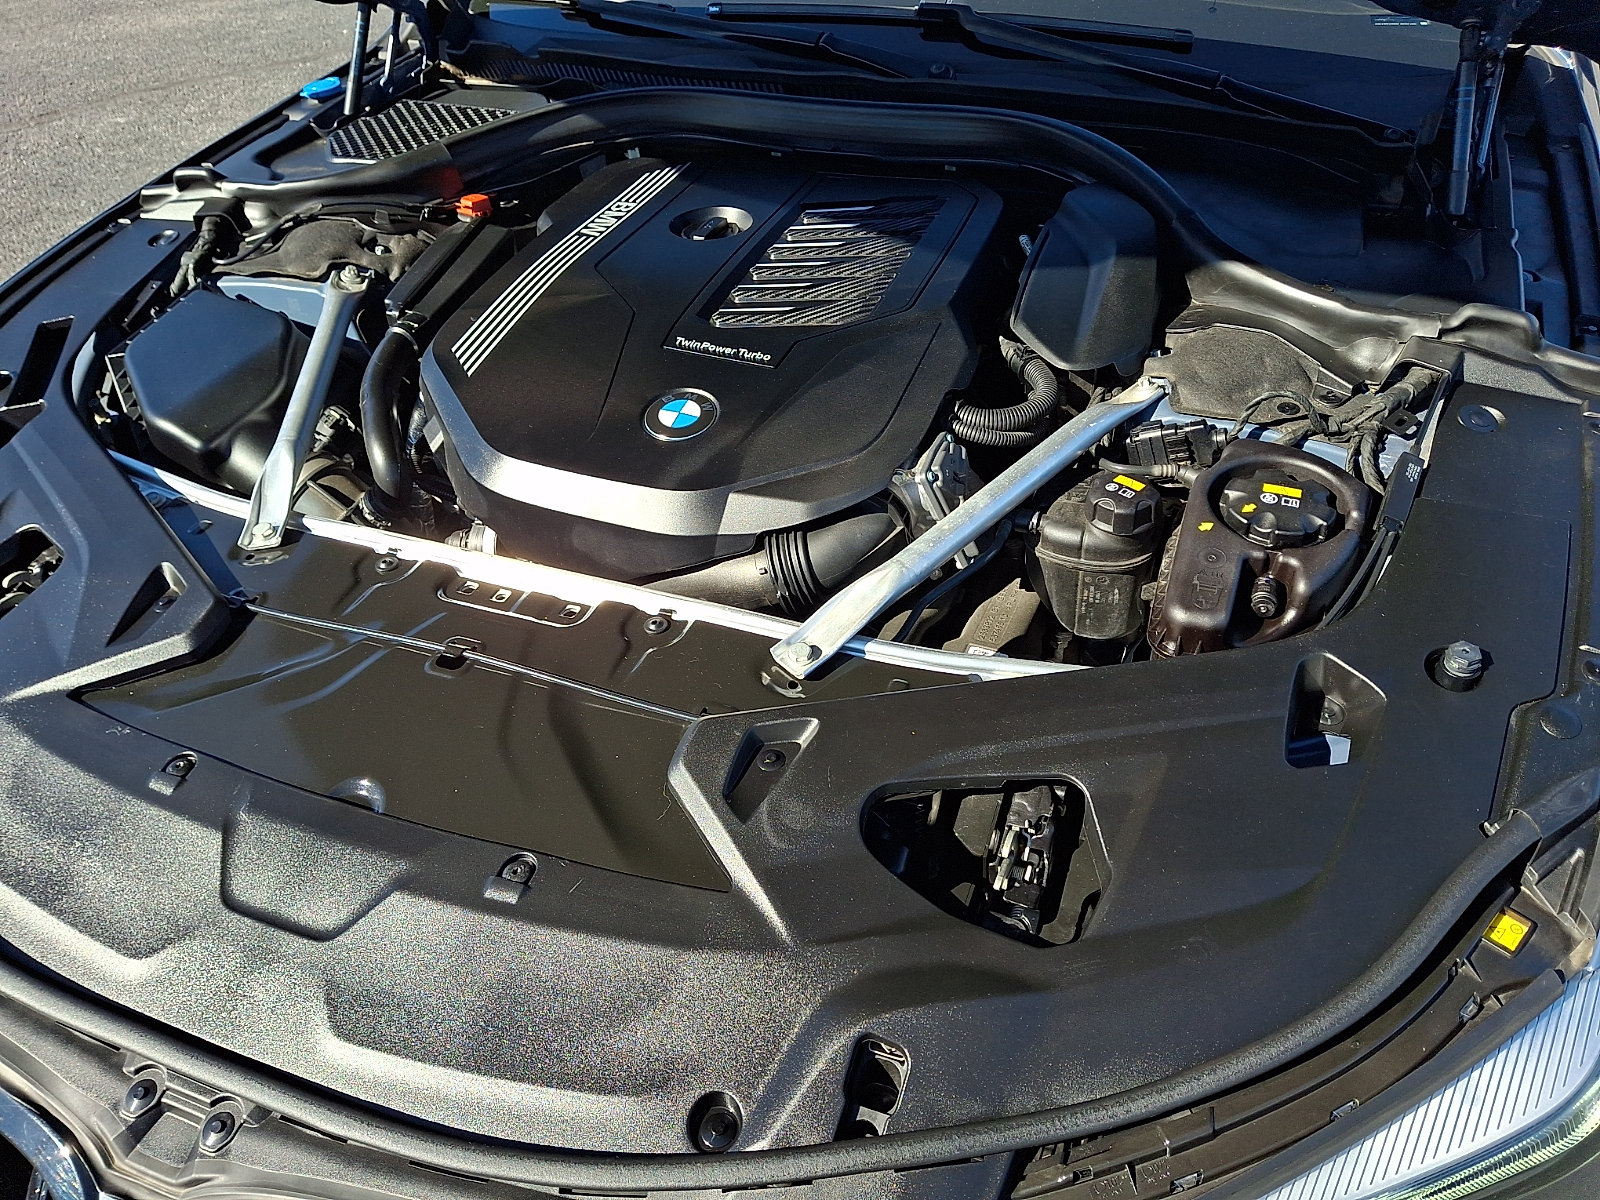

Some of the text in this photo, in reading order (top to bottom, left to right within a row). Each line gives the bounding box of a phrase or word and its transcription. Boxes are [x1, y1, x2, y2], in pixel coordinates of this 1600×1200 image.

[580, 201, 638, 237] BMW
[738, 347, 772, 361] Turbo
[661, 392, 714, 411] BMW
